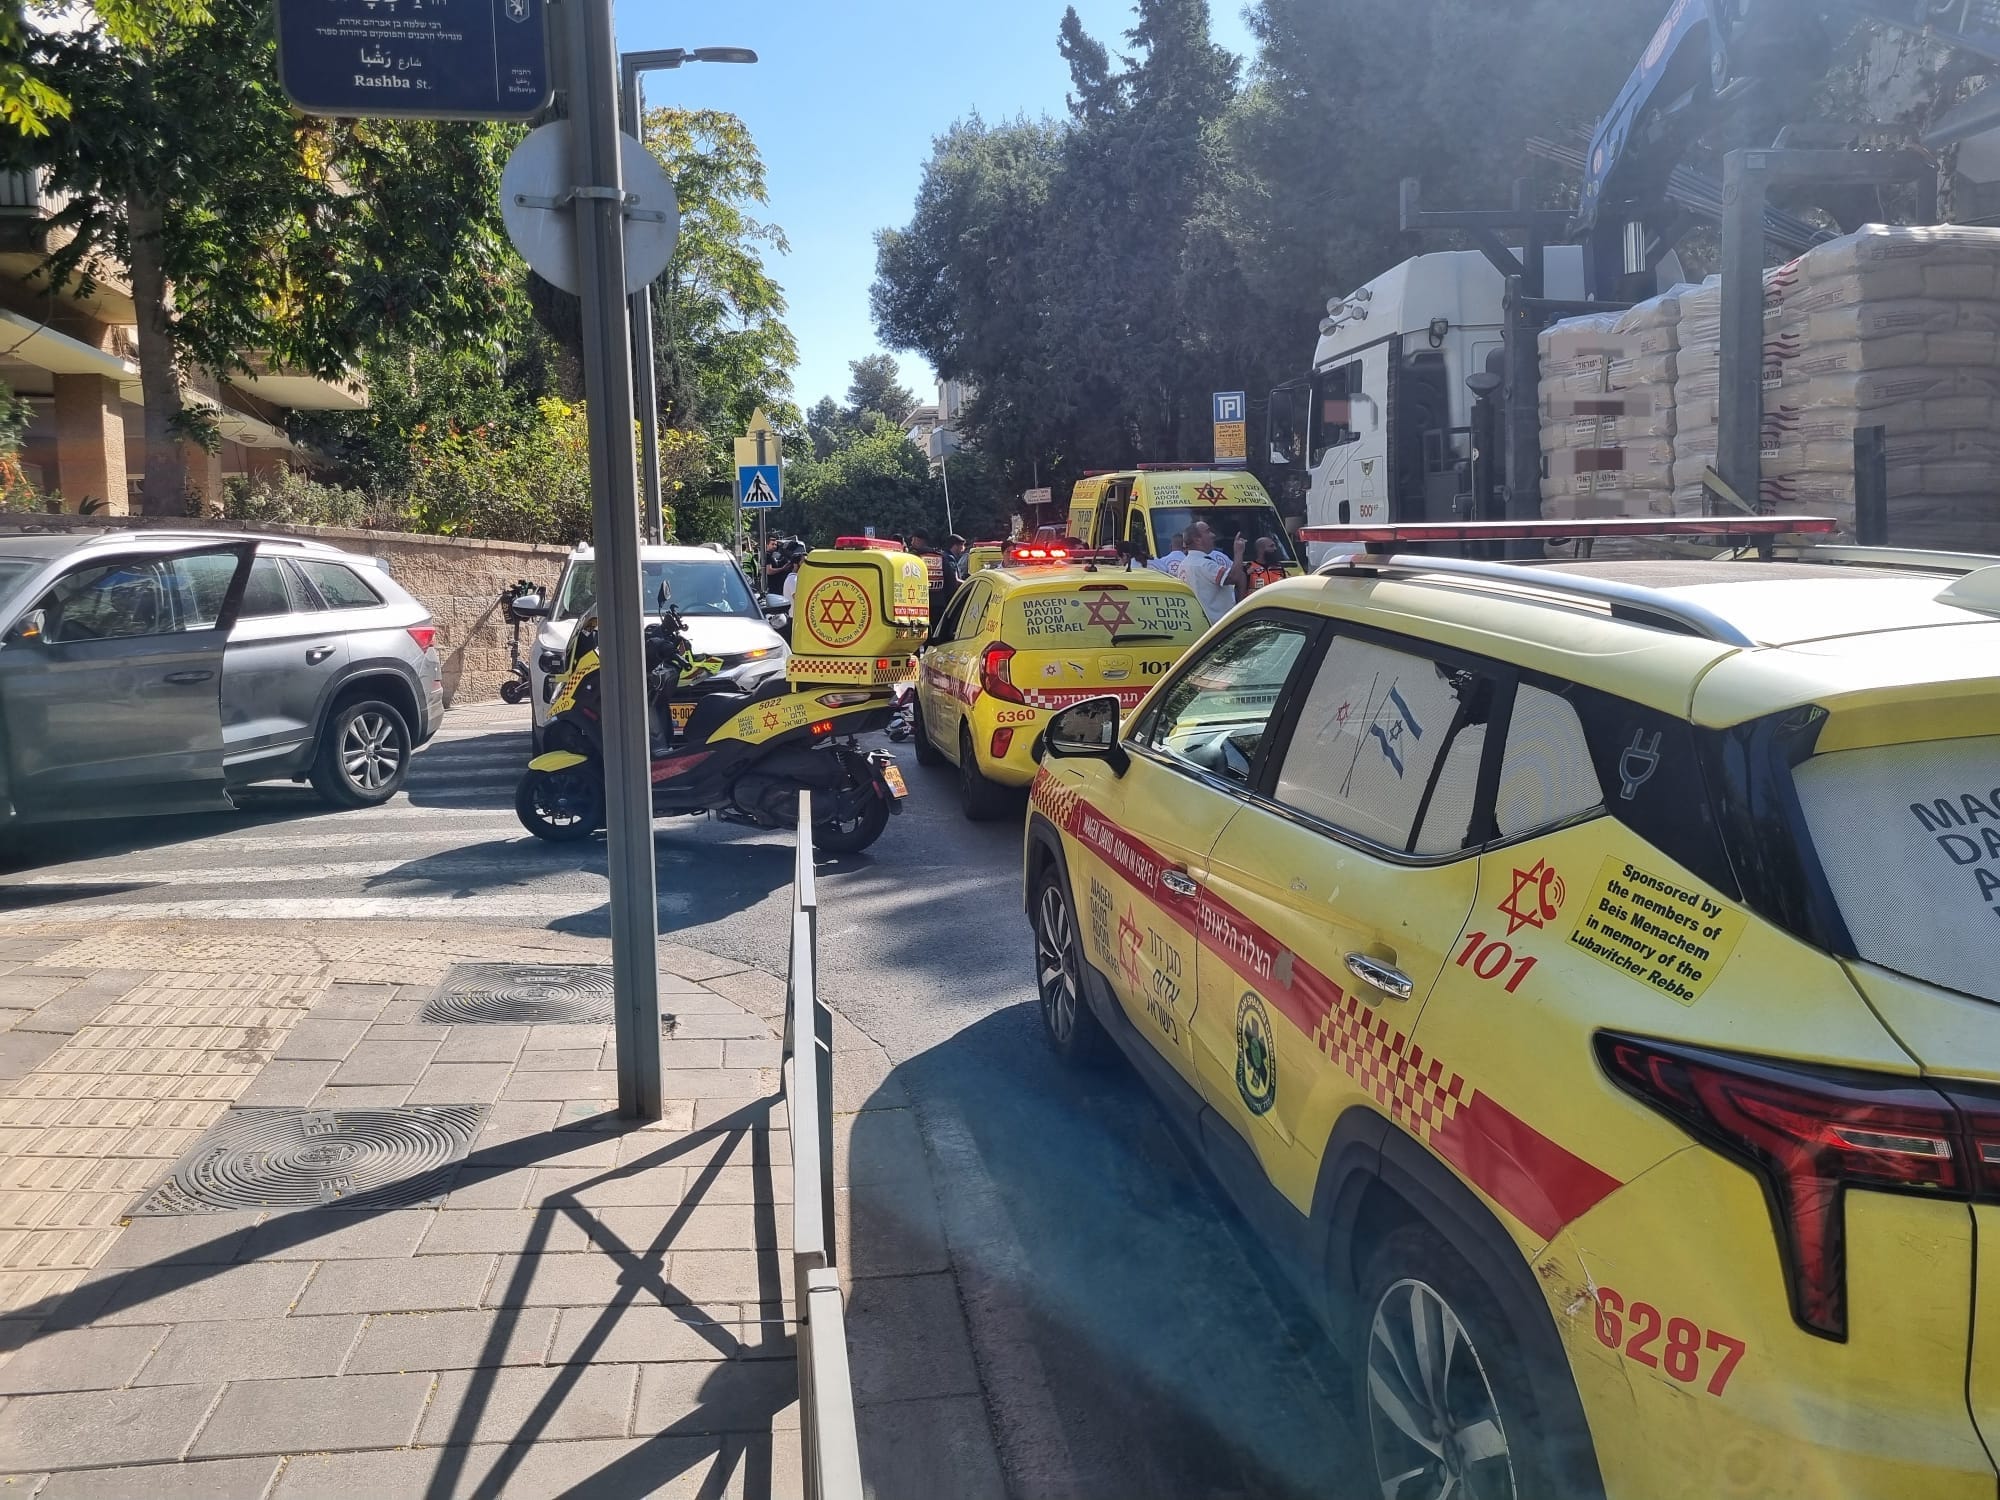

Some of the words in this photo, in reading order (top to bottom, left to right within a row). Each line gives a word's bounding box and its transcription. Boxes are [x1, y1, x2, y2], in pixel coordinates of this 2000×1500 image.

[354, 75, 411, 88] Rashba
[1023, 598, 1067, 609] MAGEN
[1024, 606, 1063, 618] DAVID
[1136, 596, 1160, 606] דוד
[1156, 607, 1191, 619] אדום
[1165, 596, 1186, 609] מגן
[1026, 615, 1065, 626] ADOM
[1027, 626, 1040, 636] IN
[1045, 622, 1085, 634] ISRAEL
[1137, 618, 1193, 632] בישראל
[758, 698, 782, 711] 5022
[996, 709, 1036, 723] 6360
[1083, 812, 1100, 842] MAGEN
[1098, 825, 1114, 854] DAVID
[1112, 838, 1130, 869] ADOM
[1128, 849, 1137, 874] IN
[1134, 854, 1154, 889] ISRAEL
[1090, 876, 1113, 911] MAGEN
[1622, 864, 1700, 907] Sponsored
[1701, 898, 1722, 919] by
[1607, 879, 1629, 898] the
[1631, 892, 1700, 932] members
[1702, 926, 1723, 941] of
[1147, 926, 1163, 962] דוד
[1200, 904, 1237, 953] הלאומי
[1598, 897, 1628, 921] Beis
[1630, 913, 1710, 962] Menachem
[1165, 944, 1182, 978] מגן
[1455, 931, 1539, 994] 101
[1571, 929, 1647, 977] Lubavitcher
[1646, 970, 1694, 1001] Rebbe
[1585, 914, 1599, 930] in
[1600, 924, 1656, 960] memory
[1657, 953, 1677, 967] of
[1676, 960, 1703, 982] the
[1152, 968, 1181, 1013] אדום
[1142, 981, 1180, 1046] בישראל
[1594, 1286, 1746, 1398] 6287
